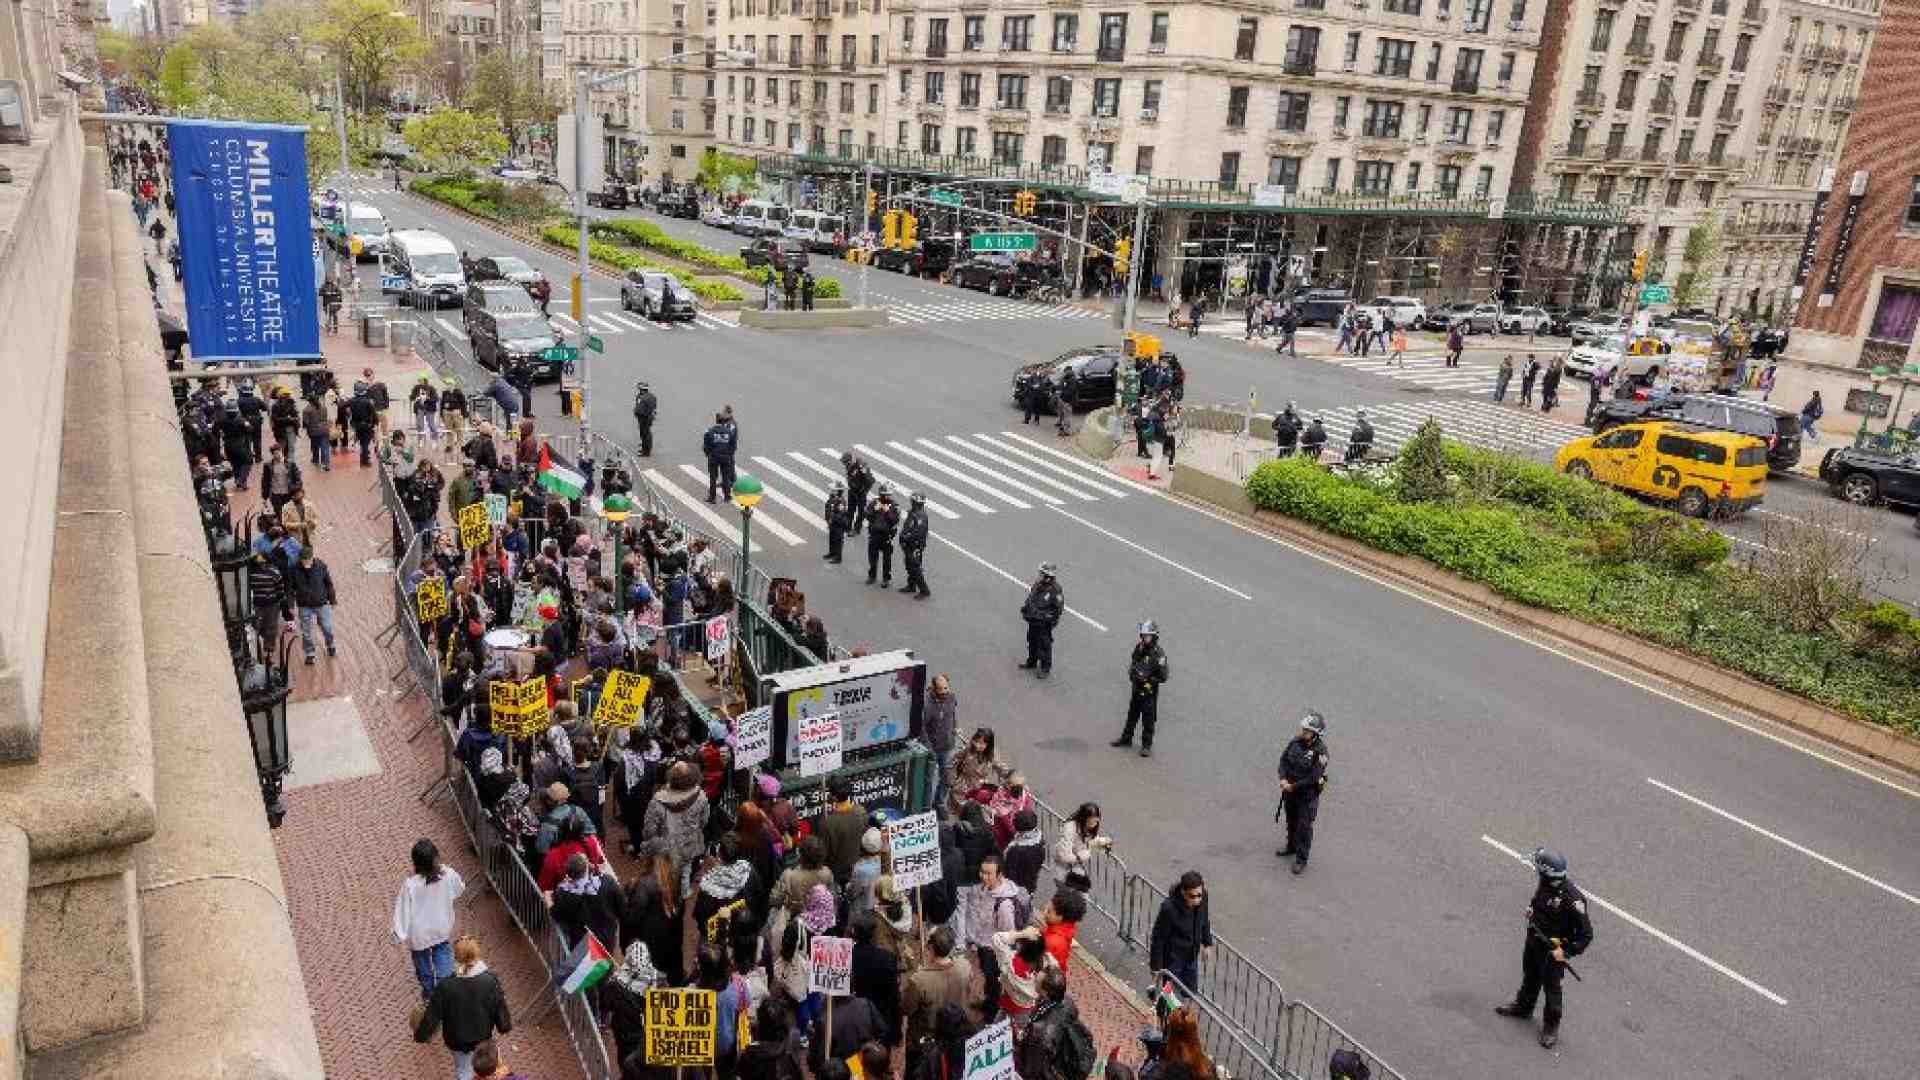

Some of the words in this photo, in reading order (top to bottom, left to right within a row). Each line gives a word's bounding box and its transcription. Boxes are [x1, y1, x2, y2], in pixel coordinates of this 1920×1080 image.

[226, 139, 247, 236] COLUMBIA
[234, 242, 256, 342] UNIVERSITY
[895, 831, 935, 849] NOW!
[650, 991, 680, 1009] END
[685, 992, 712, 1009] ALL
[652, 1009, 680, 1027] U.S.
[685, 1009, 711, 1027] AID
[652, 1039, 709, 1056] ISRAEL!
[967, 1040, 1014, 1077] ALL
